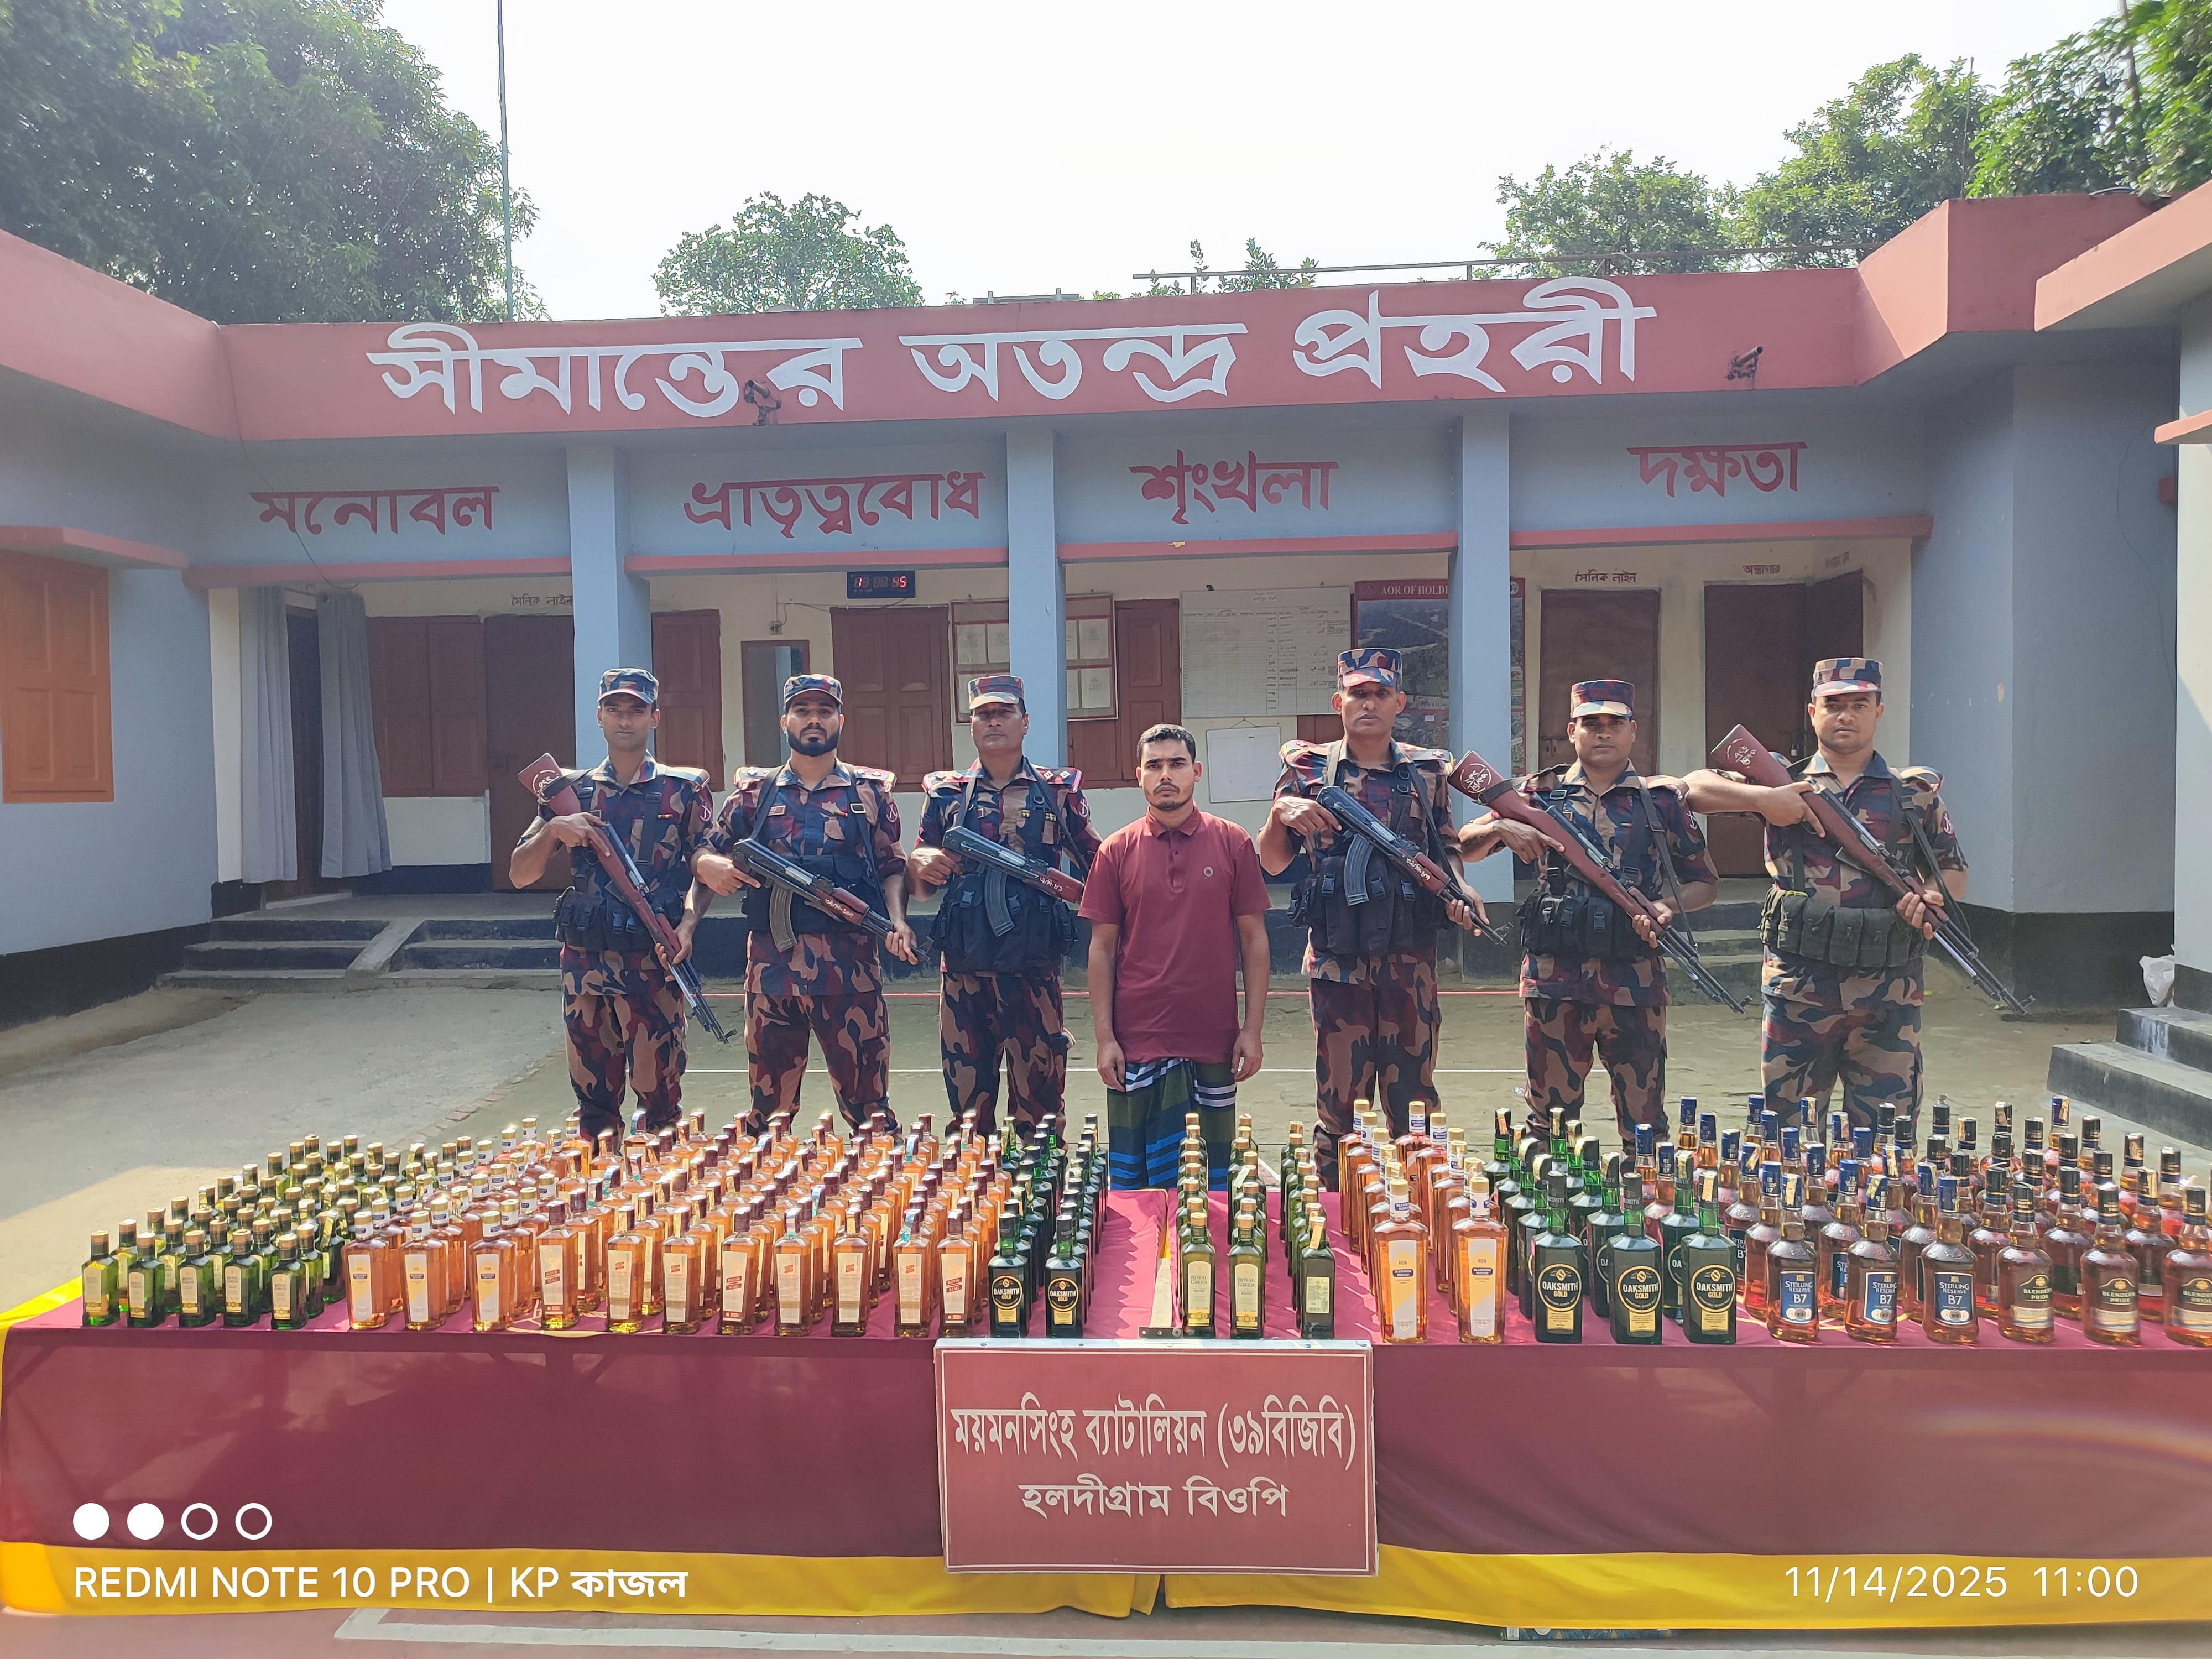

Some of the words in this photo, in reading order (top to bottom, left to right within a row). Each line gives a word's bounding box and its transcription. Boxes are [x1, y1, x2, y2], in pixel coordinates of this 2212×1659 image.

[366, 322, 862, 416] সীমান্তের
[898, 323, 1248, 402] অতন্দ্র
[1293, 277, 1656, 393] প্রহরী
[1629, 442, 1808, 498] দক্ষতা
[1130, 449, 1339, 524] শৃংখলা
[249, 487, 499, 535] মনোবল
[1611, 570, 1637, 583] লাইন
[1381, 586, 1401, 595] AOR
[1404, 586, 1416, 595] OF
[1418, 585, 1448, 594] HOLDI
[1542, 1281, 1578, 1291] OAKSMITH
[1623, 1283, 1658, 1293] OAKSMITH
[1696, 1282, 1733, 1292] OAKSMITH
[1793, 1293, 1807, 1303] B7
[1880, 1295, 1892, 1305] B7
[1948, 1295, 1963, 1305] B7
[950, 1392, 1076, 1463] ময়মনসিংহ
[1083, 1392, 1208, 1457] ব্যাটালিয়ন
[1217, 1394, 1357, 1472] (৩৯বিজিবি)
[1017, 1473, 1173, 1519] হলদীগ্রাম
[1182, 1475, 1290, 1517] বিওপি
